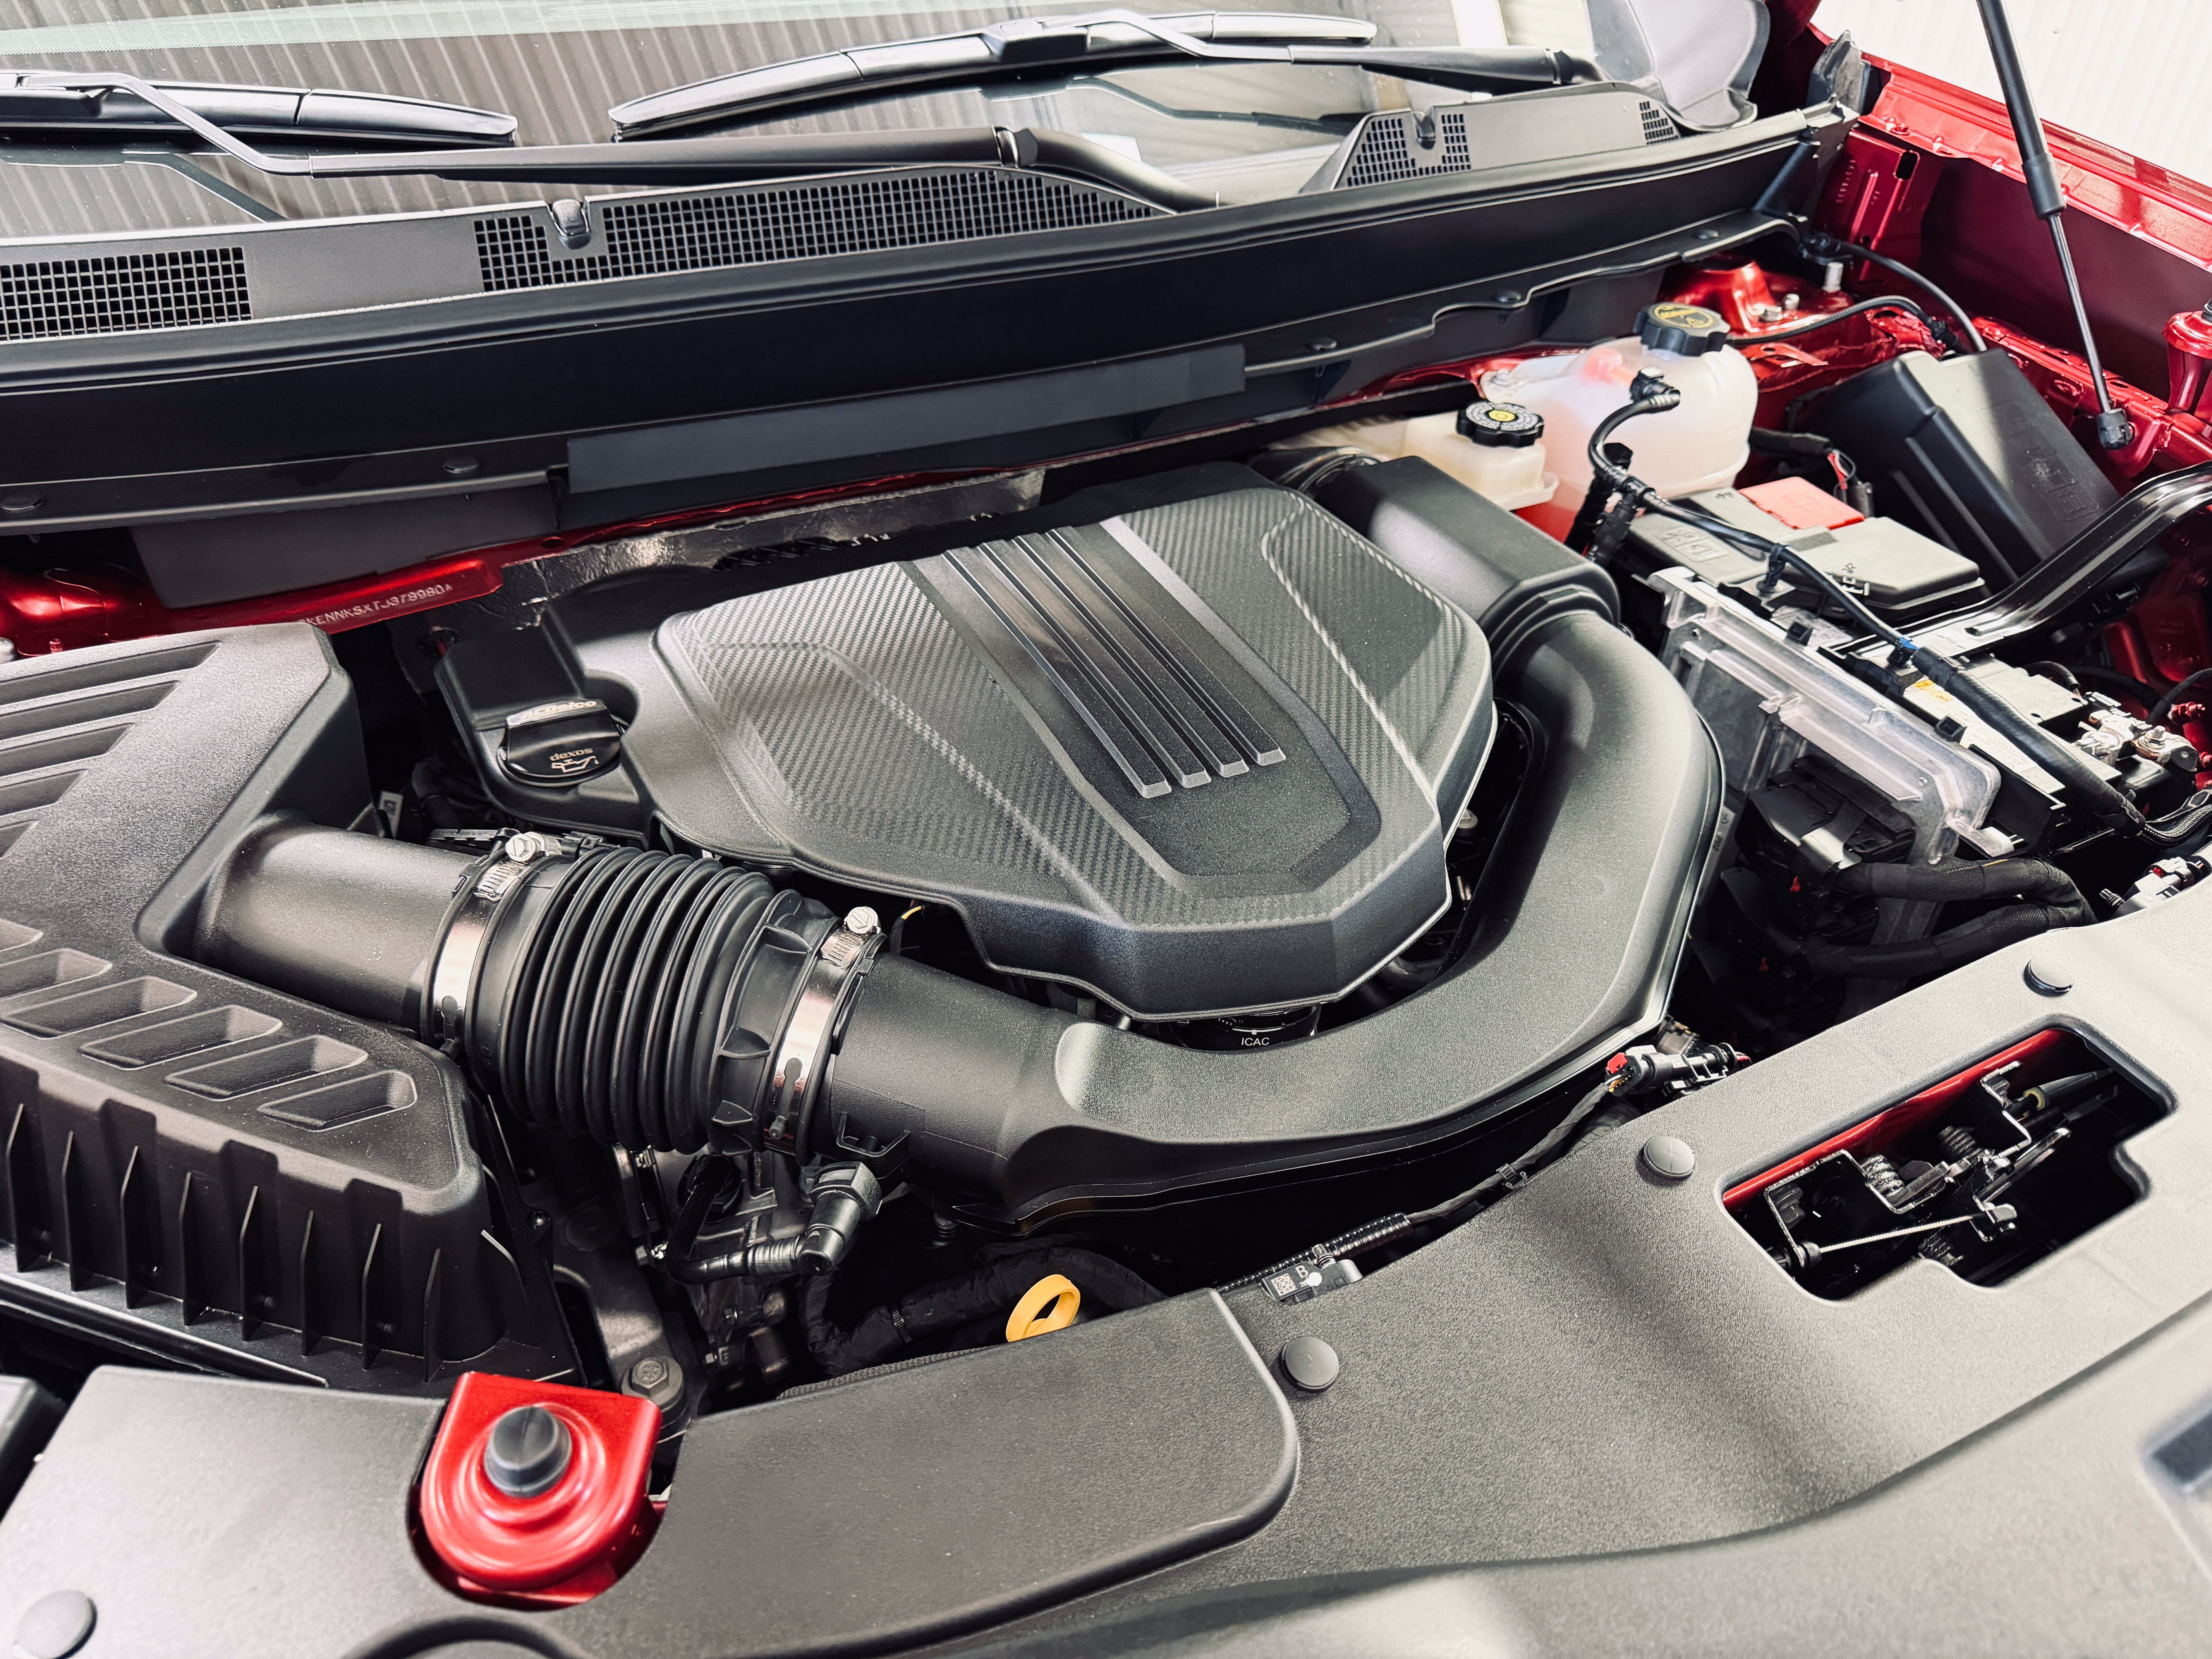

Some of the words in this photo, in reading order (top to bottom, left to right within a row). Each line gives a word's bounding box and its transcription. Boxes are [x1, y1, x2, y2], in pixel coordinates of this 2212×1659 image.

[523, 701, 597, 720] ACDelco
[550, 748, 594, 761] dexos
[1241, 1037, 1270, 1046] ICAC
[1295, 1265, 1309, 1278] B
